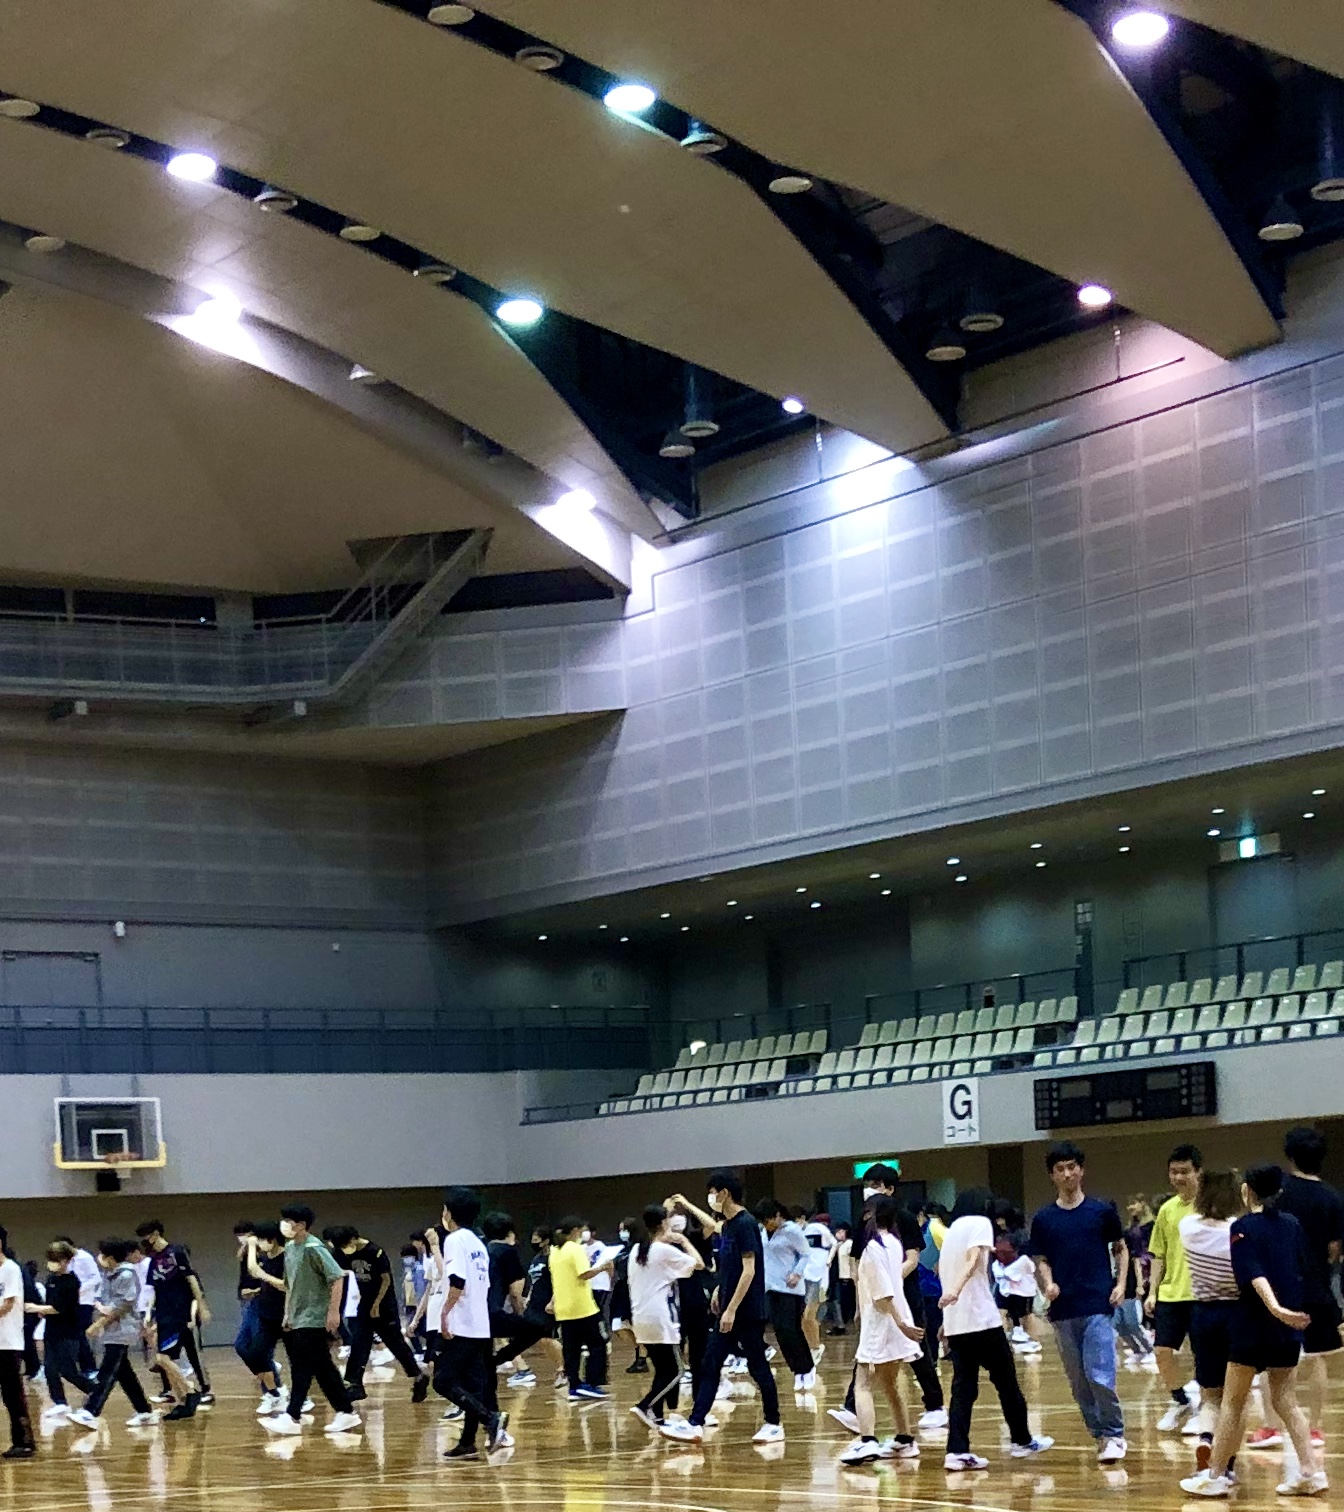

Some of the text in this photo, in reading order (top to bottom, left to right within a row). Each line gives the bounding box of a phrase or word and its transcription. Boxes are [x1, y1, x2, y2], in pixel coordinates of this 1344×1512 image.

[950, 1084, 972, 1120] G
[947, 1124, 976, 1137] コート
